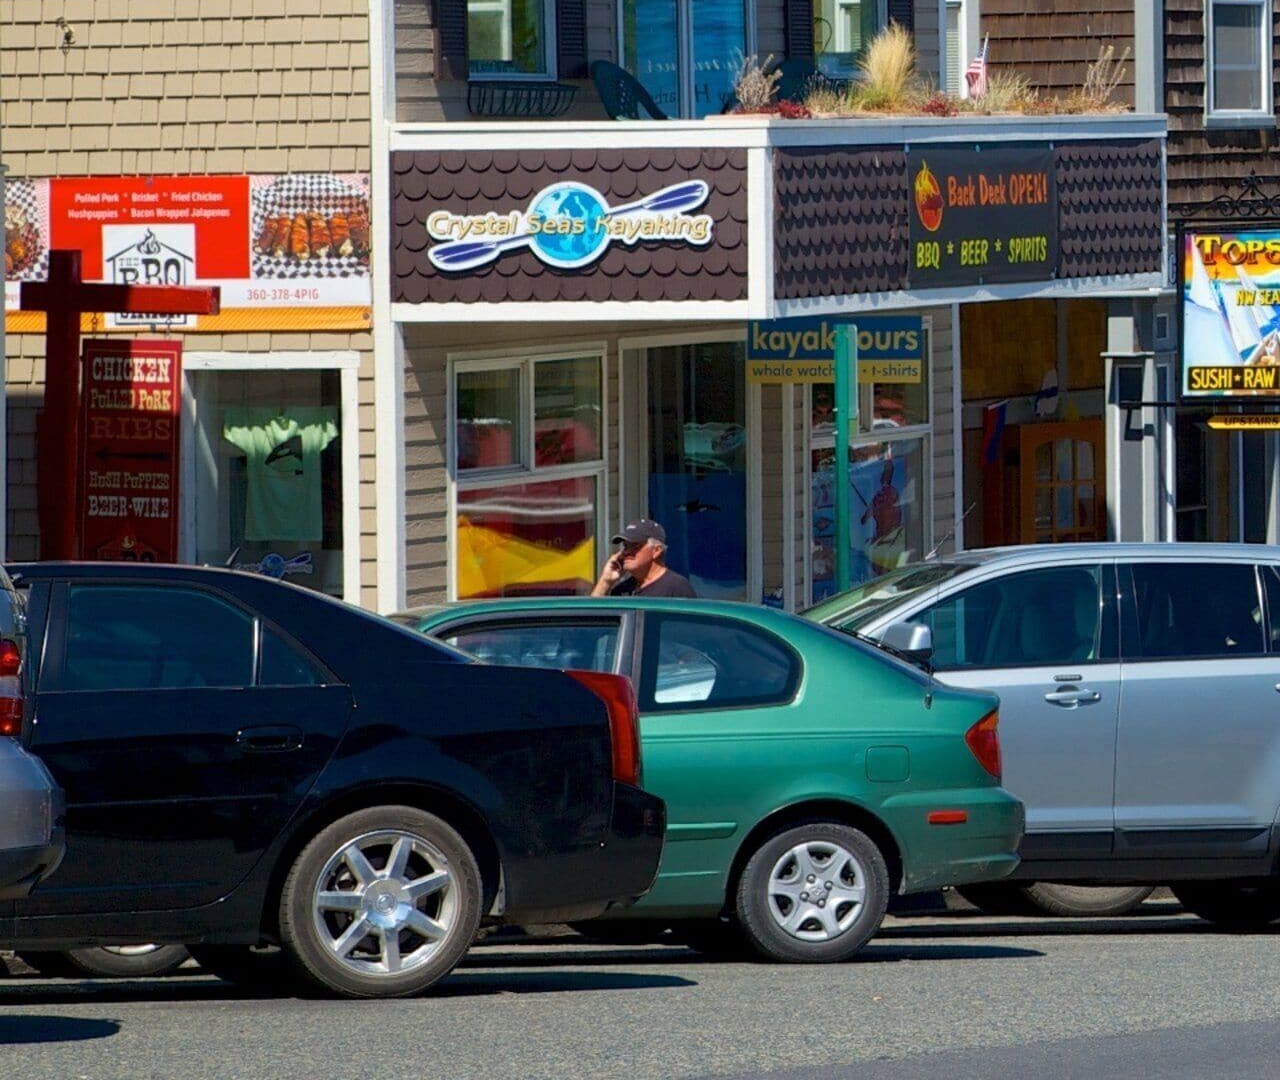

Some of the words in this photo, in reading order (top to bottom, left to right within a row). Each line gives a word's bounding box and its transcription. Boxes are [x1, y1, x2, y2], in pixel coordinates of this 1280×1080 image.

[102, 193, 119, 203] Pork
[131, 193, 159, 203] Brisket
[171, 192, 191, 202] Fried
[192, 192, 223, 202] Chicken
[948, 176, 976, 207] Back
[979, 174, 1006, 205] Deck
[1009, 172, 1048, 204] OPEN!
[131, 208, 155, 218] Bacon
[429, 214, 517, 240] Crystal
[525, 214, 586, 235] Seas
[595, 215, 709, 241] Kayaking
[916, 240, 941, 269] BBQ
[960, 238, 989, 266] BEER
[1007, 236, 1048, 264] SPIRITS
[247, 288, 320, 301] 360-378-4PIG
[1236, 289, 1257, 306] NW
[753, 321, 836, 358] kayak
[857, 329, 919, 351] ours
[91, 356, 171, 384] CHICKEN
[753, 364, 793, 378] whale
[872, 365, 919, 378] t-shirts
[1191, 367, 1233, 389] SUSHI
[1243, 367, 1276, 389] RAW
[139, 390, 172, 411] PORK
[90, 416, 171, 441] RIBS
[1224, 415, 1280, 427] UPSTAIRS
